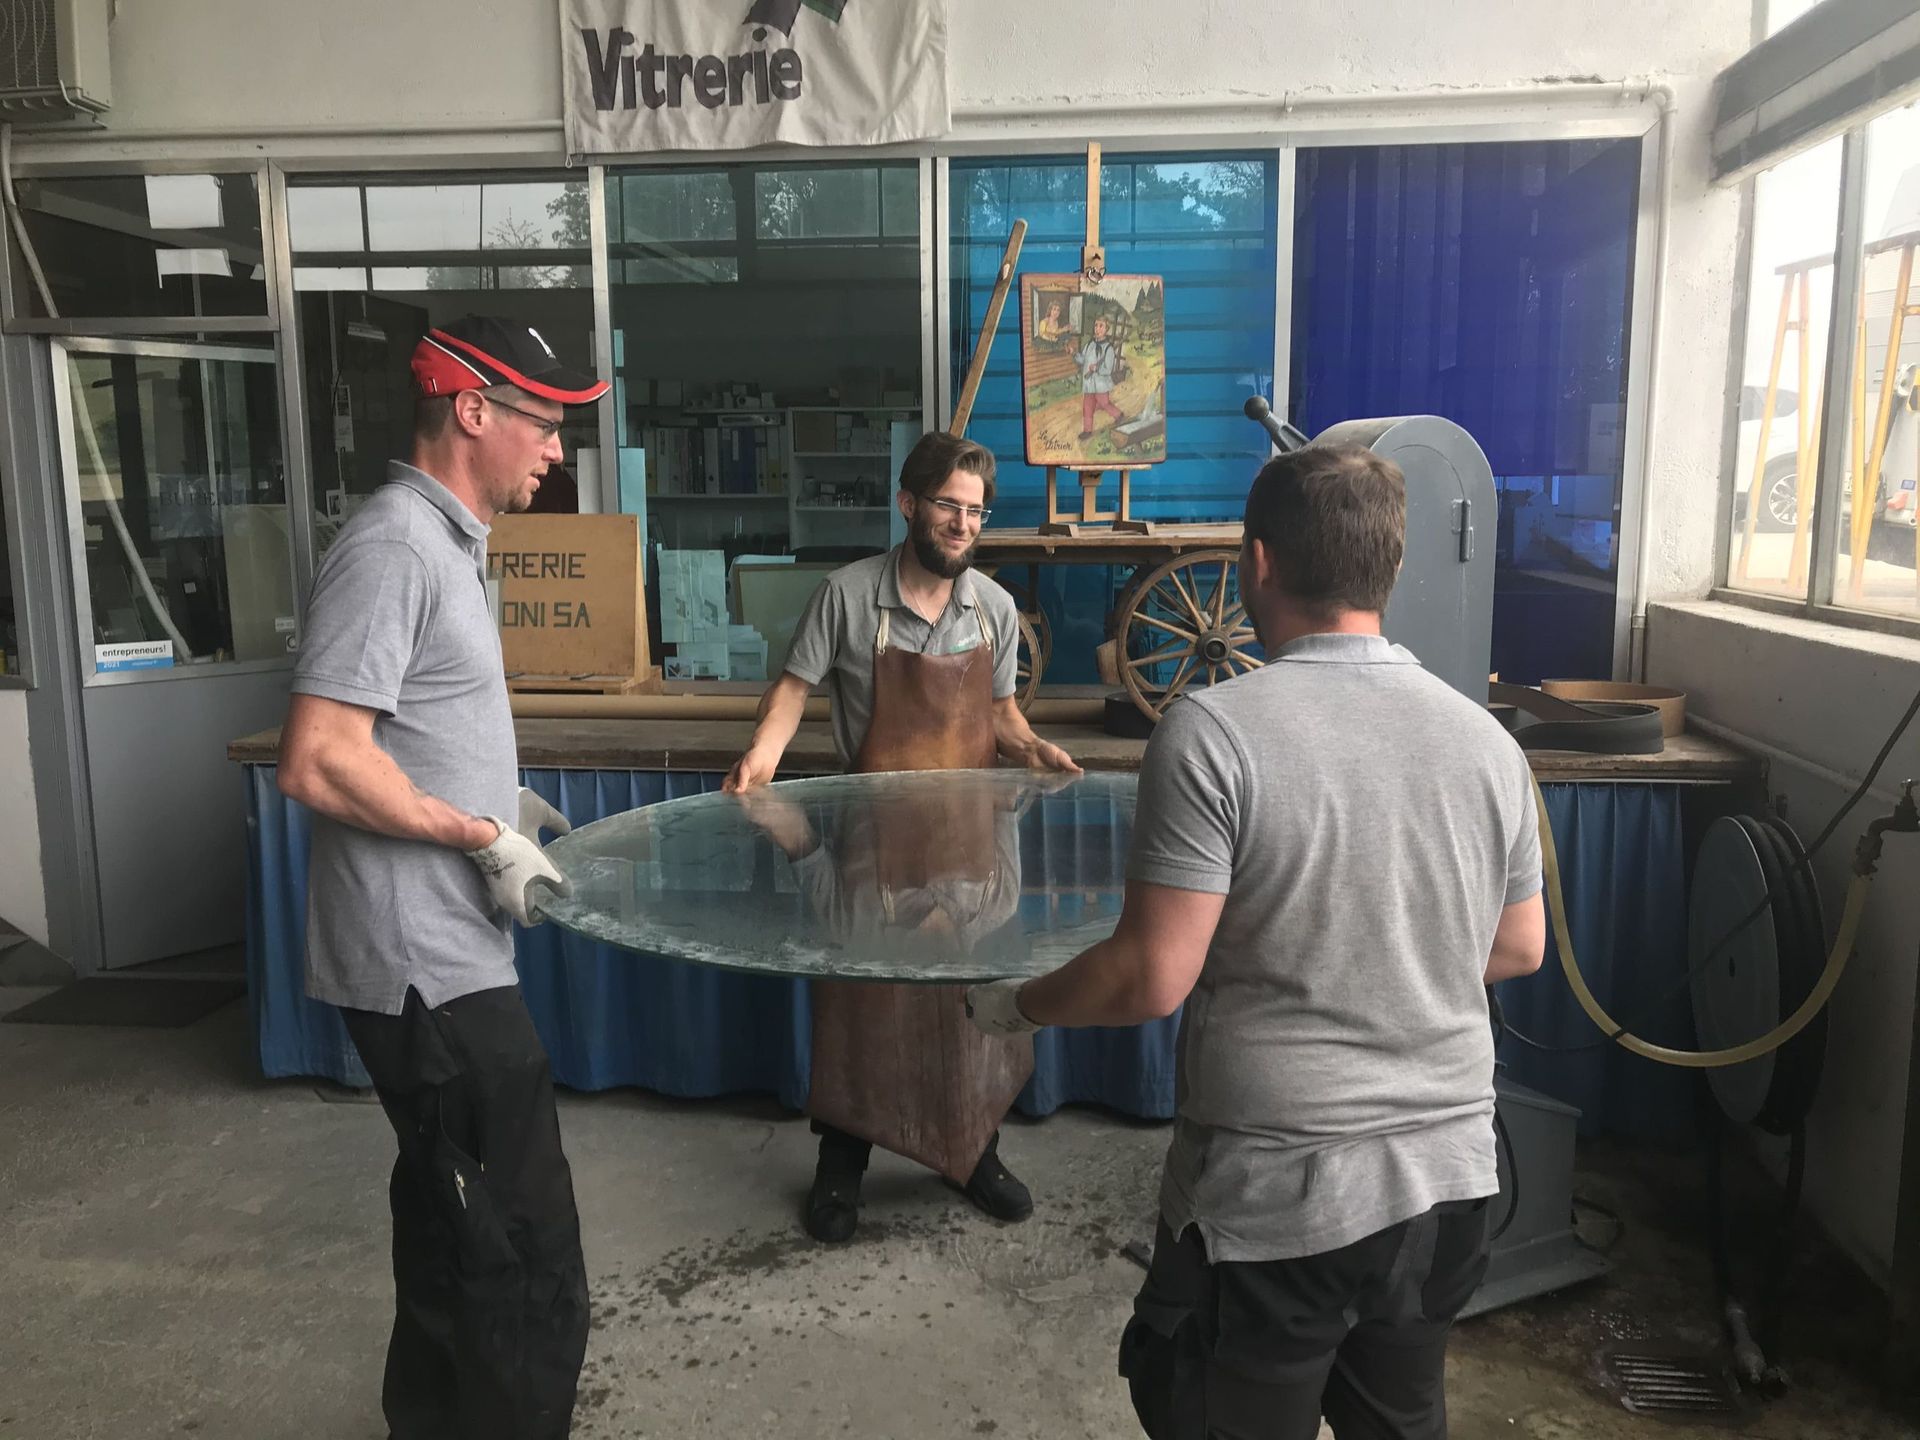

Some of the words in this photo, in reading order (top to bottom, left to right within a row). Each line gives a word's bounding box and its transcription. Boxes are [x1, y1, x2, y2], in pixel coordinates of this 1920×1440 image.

[581, 26, 803, 111] Vitrerie
[553, 601, 591, 628] SA
[102, 644, 166, 657] entrepreneurs!
